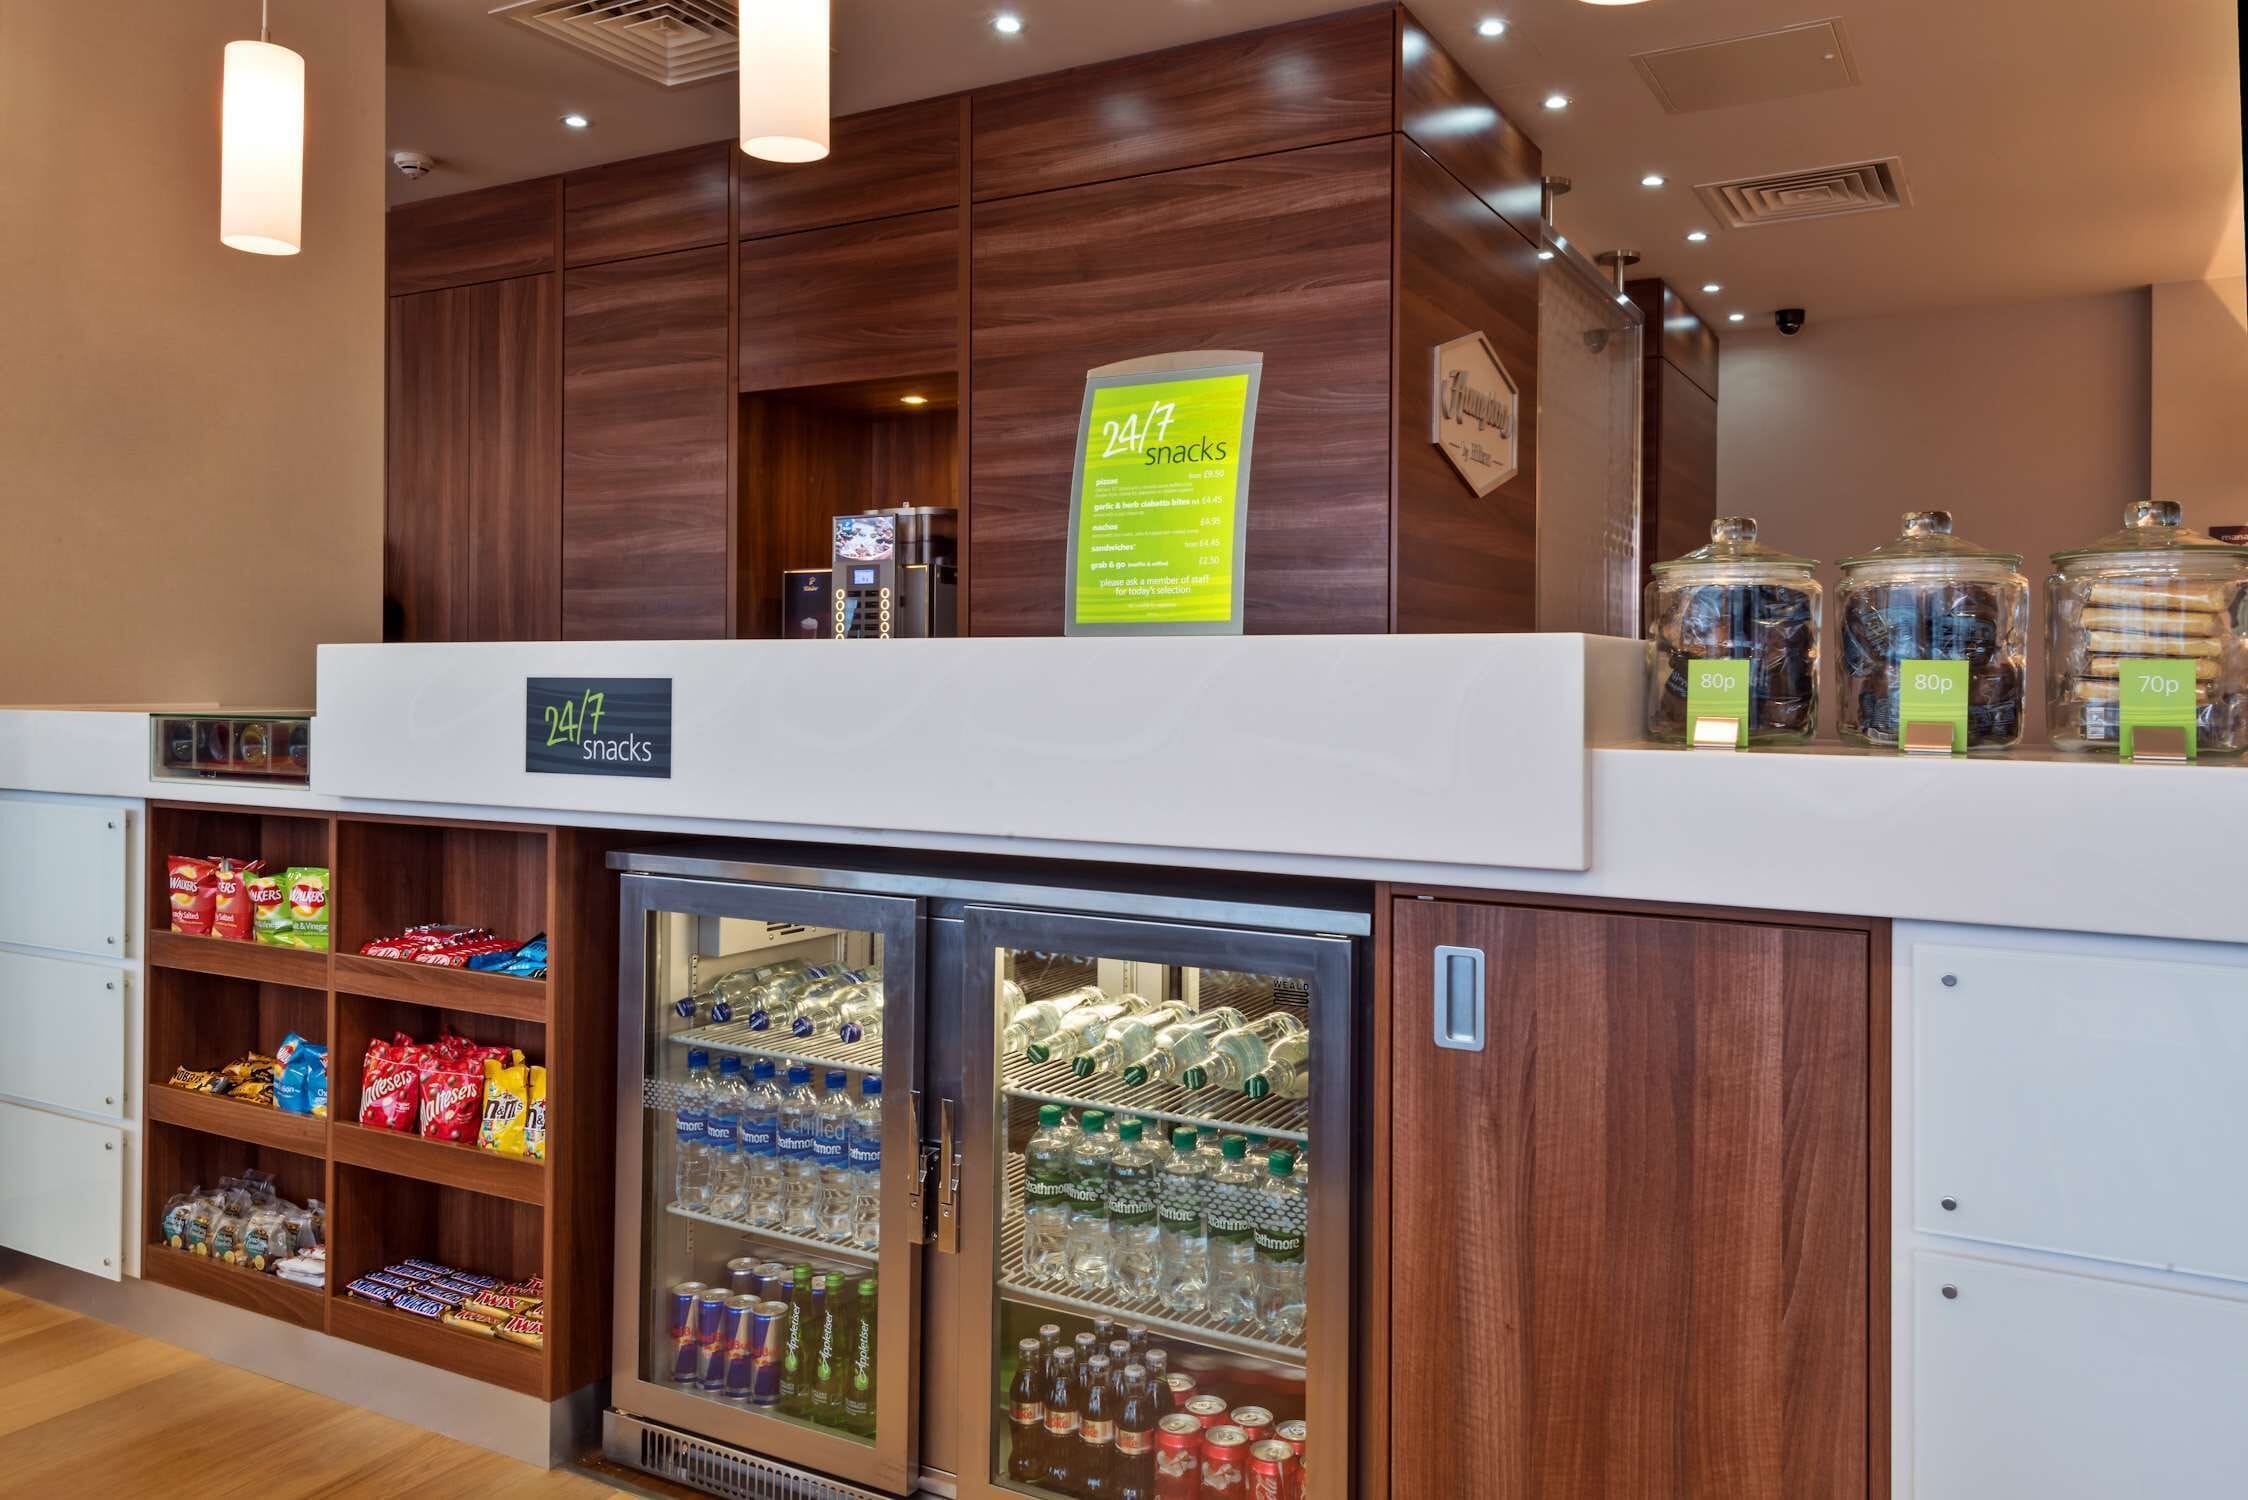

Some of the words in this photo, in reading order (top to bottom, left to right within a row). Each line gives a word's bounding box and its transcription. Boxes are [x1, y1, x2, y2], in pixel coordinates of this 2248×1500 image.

[1102, 400, 1176, 459] 24/7
[1144, 435, 1228, 467] snacks
[1114, 501, 1121, 509] &
[1122, 500, 1139, 510] herb
[1171, 497, 1190, 506] bites
[1091, 561, 1108, 571] grab
[1109, 560, 1115, 569] &
[1116, 561, 1127, 571] go
[1100, 578, 1124, 589] please
[1126, 577, 1138, 587] ask
[1146, 575, 1179, 585] member
[1180, 575, 1190, 585] of
[1191, 574, 1210, 584] staff
[1115, 586, 1127, 596] for
[1128, 586, 1157, 597] today's
[1157, 585, 1192, 595] selection
[1700, 673, 1736, 692] 80p
[1914, 674, 1953, 694] 80p
[2137, 675, 2180, 696] 70p
[545, 688, 606, 746] 24/7
[582, 732, 653, 762] snacks
[169, 877, 199, 893] WALKERS
[420, 1081, 478, 1137] Maltesers
[791, 1111, 846, 1141] chilled
[393, 1295, 442, 1316] SNICKERS
[473, 1290, 518, 1310] TWIX
[786, 1301, 801, 1358] Appletiser
[818, 1309, 833, 1365] Appletiser
[855, 1318, 870, 1374] Appletiser
